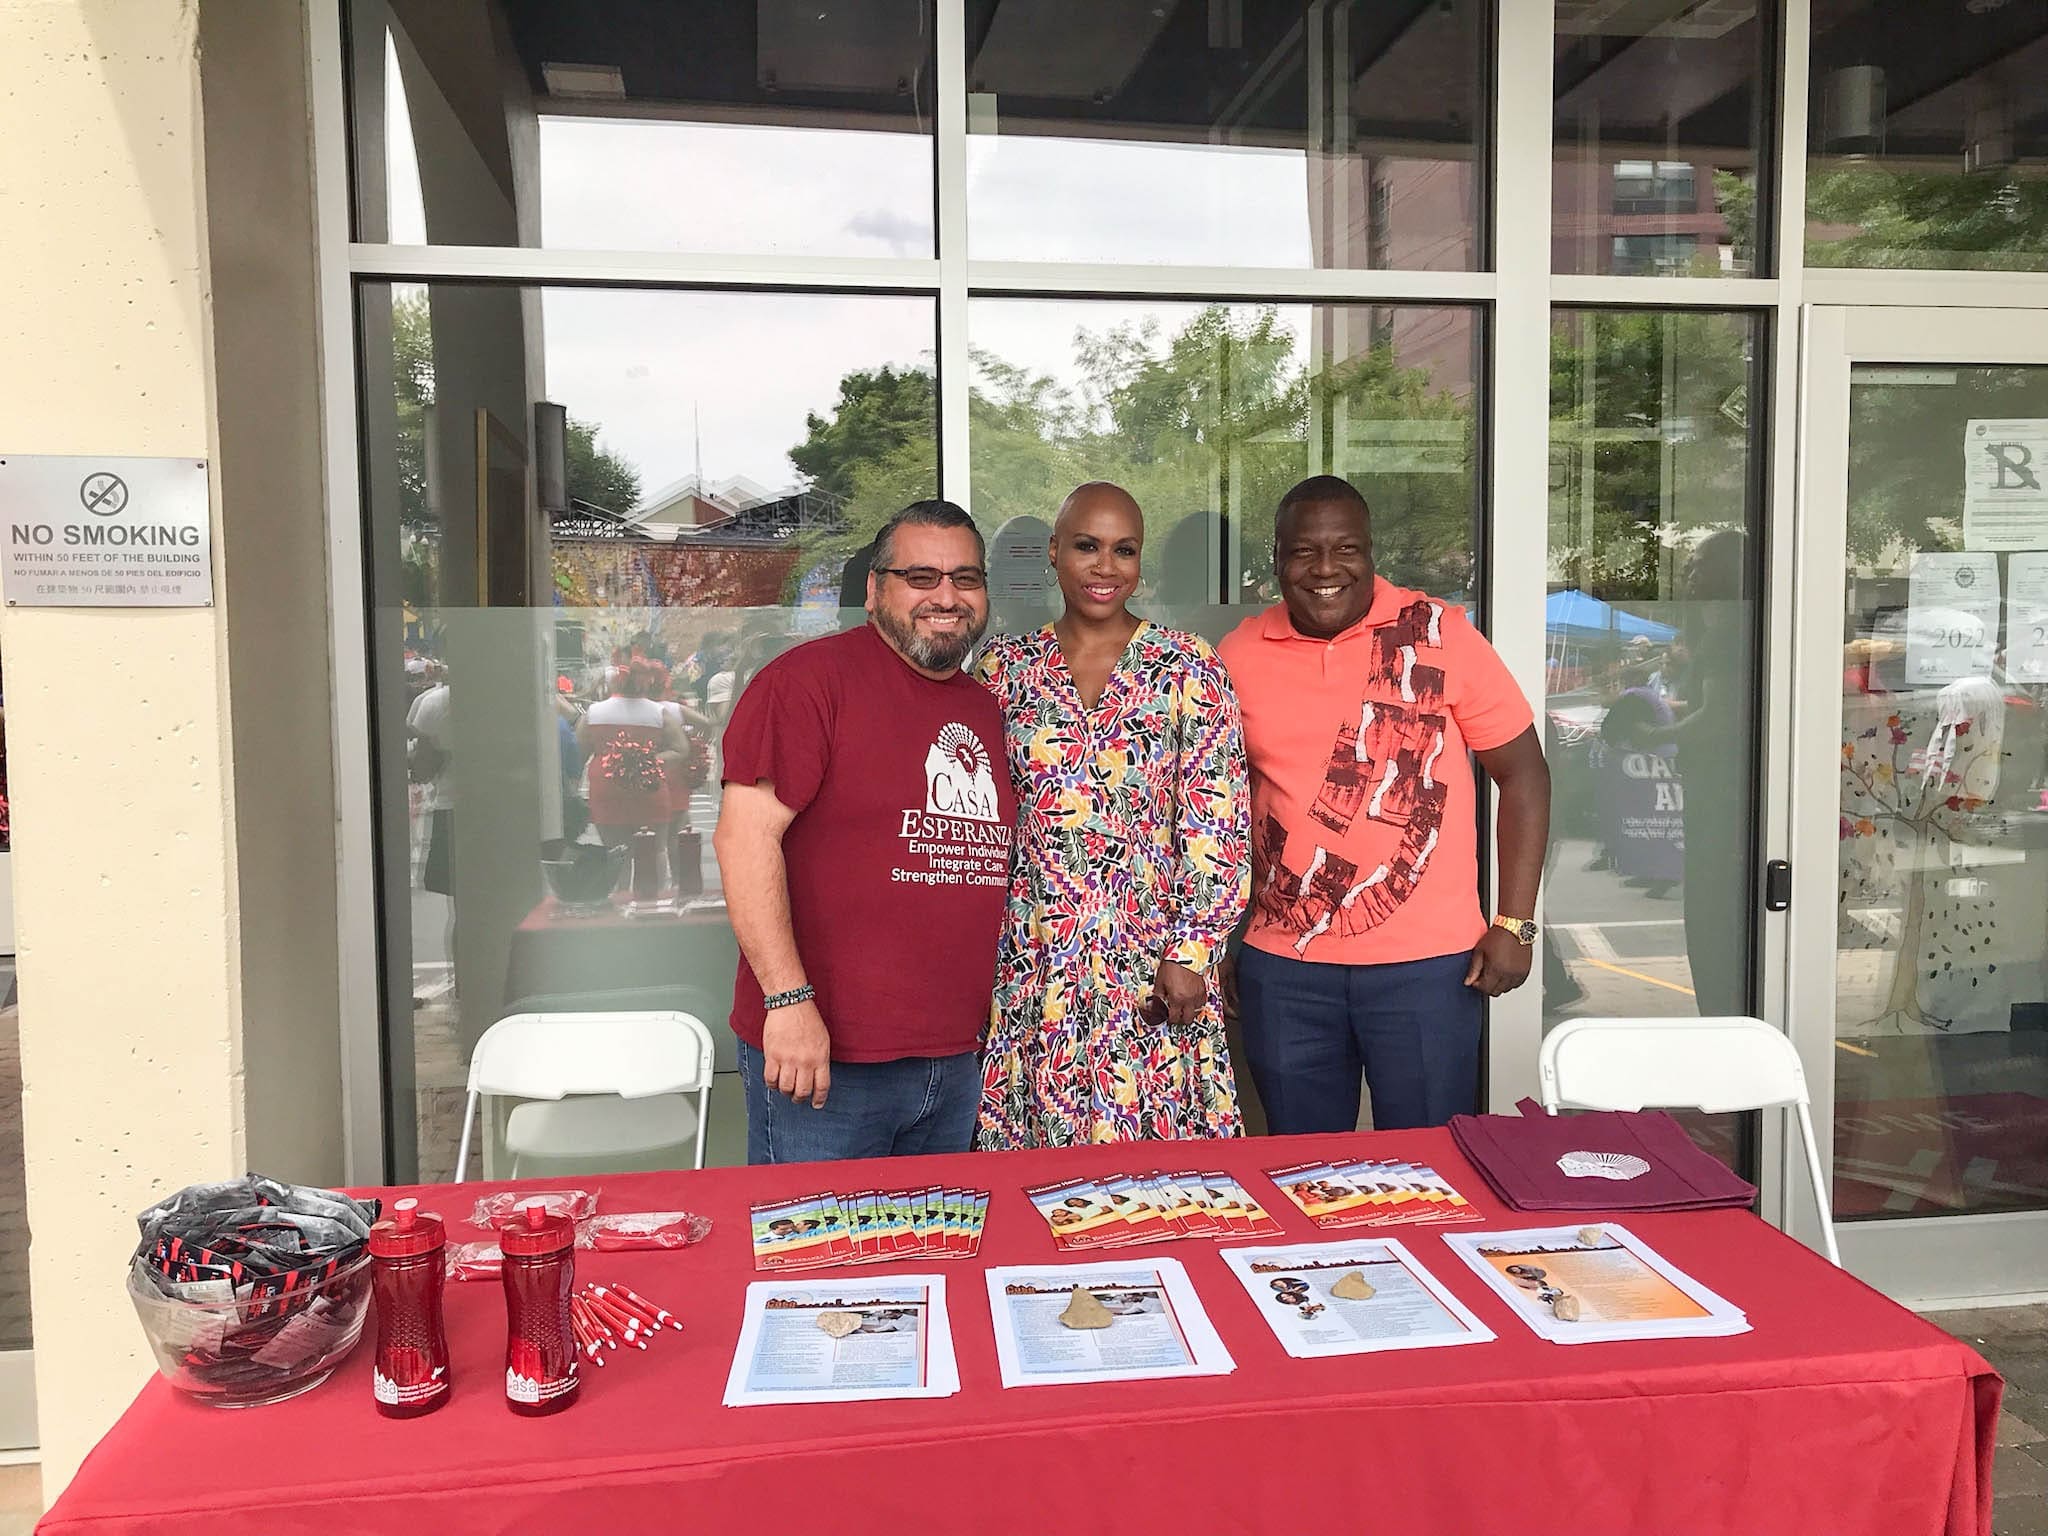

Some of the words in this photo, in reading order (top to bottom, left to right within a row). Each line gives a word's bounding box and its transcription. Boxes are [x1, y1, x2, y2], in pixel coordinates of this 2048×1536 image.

[11, 524, 54, 545] NO
[64, 525, 200, 546] SMOKING
[14, 553, 53, 563] WITHIN
[57, 553, 69, 563] 50
[72, 554, 100, 563] FEET
[104, 554, 119, 563] OF
[122, 554, 145, 563] THE
[147, 554, 200, 563] BUILDING
[14, 569, 27, 577] NO
[28, 569, 58, 577] FUMAR
[59, 569, 67, 577] A
[69, 569, 100, 577] MENOS
[102, 569, 113, 577] DE
[1931, 628, 1985, 649] 2022
[931, 772, 993, 818] CASA
[908, 839, 966, 857] Empower
[929, 855, 982, 873] Integrate
[891, 868, 963, 886] Strengthen
[1027, 1183, 1061, 1195] Welcome
[376, 1379, 396, 1394] asa
